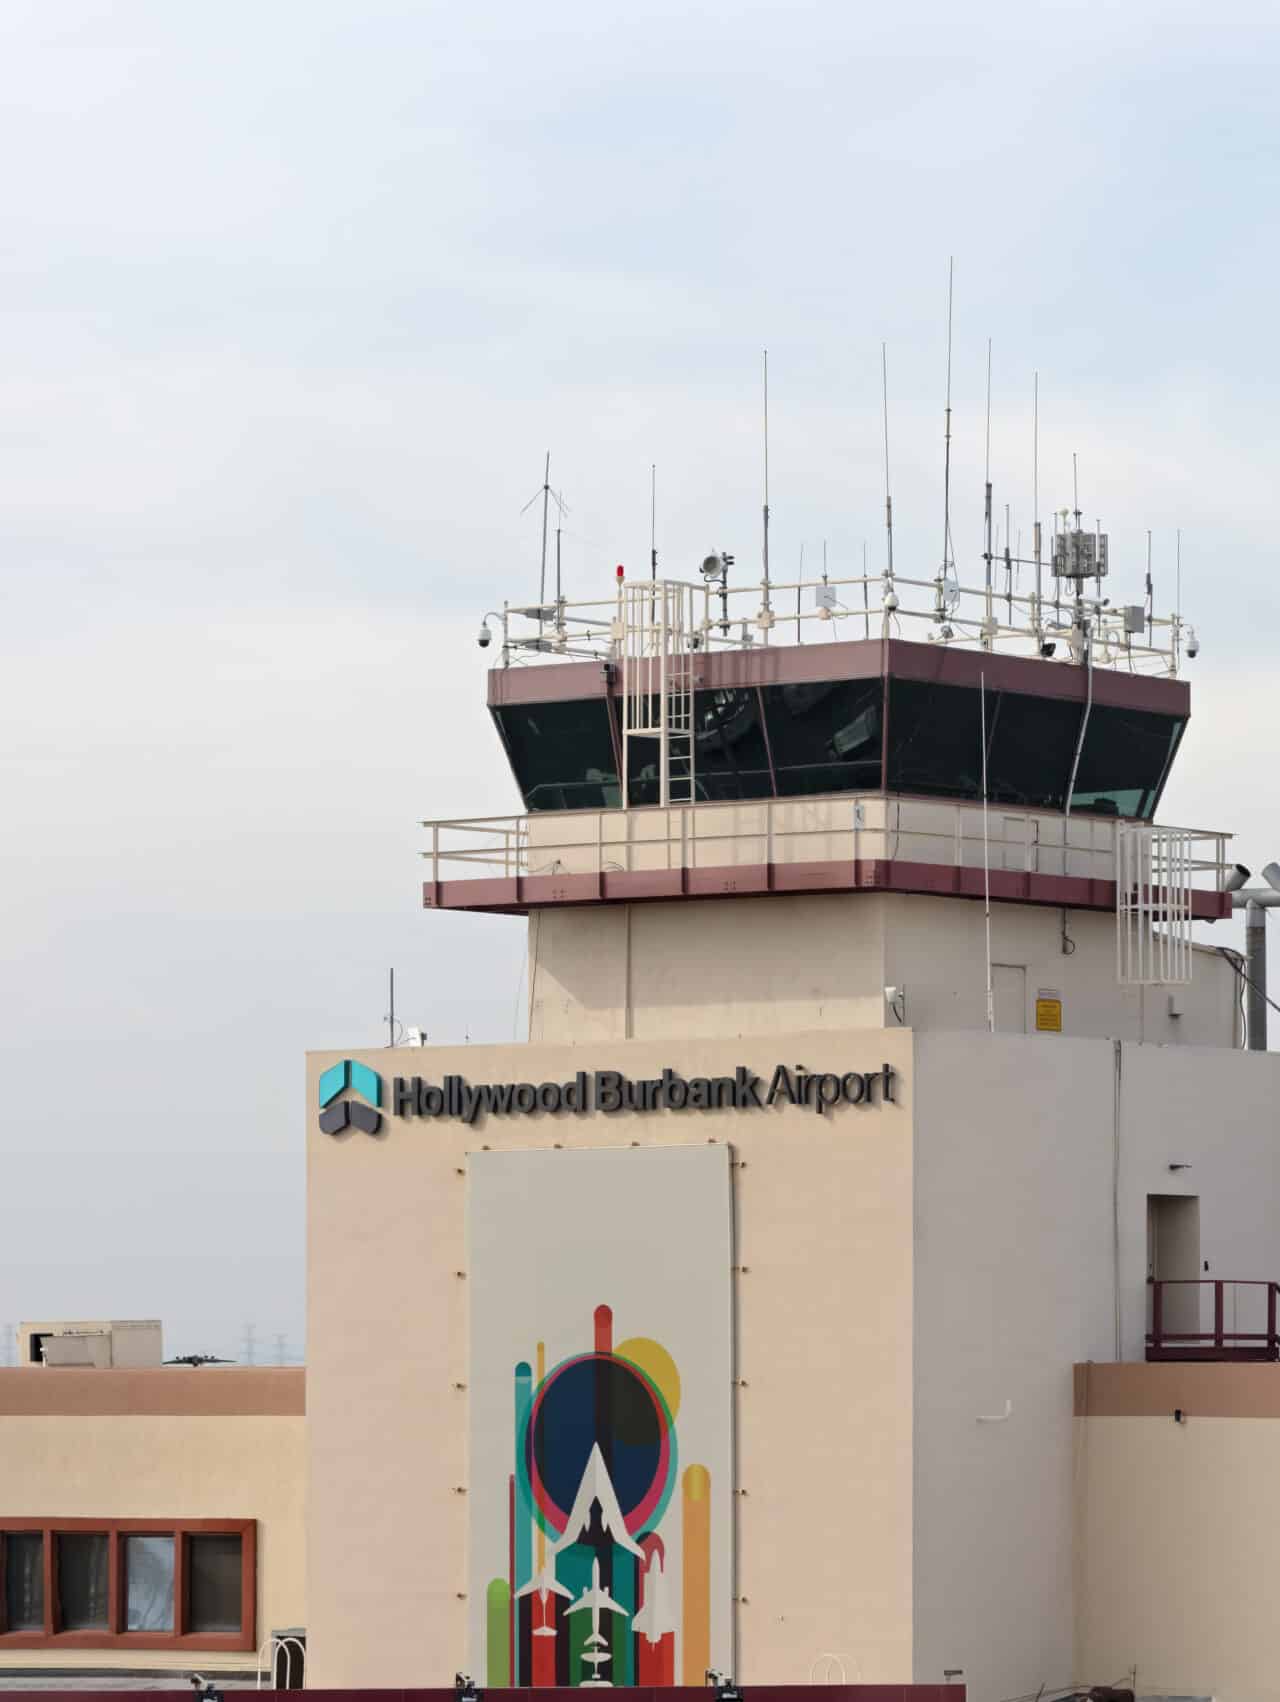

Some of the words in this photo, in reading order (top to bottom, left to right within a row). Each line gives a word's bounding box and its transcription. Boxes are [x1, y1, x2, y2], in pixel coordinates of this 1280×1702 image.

[393, 1071, 588, 1123] Hollywood
[595, 1066, 761, 1112] Burbank
[767, 1063, 896, 1114] Airport
